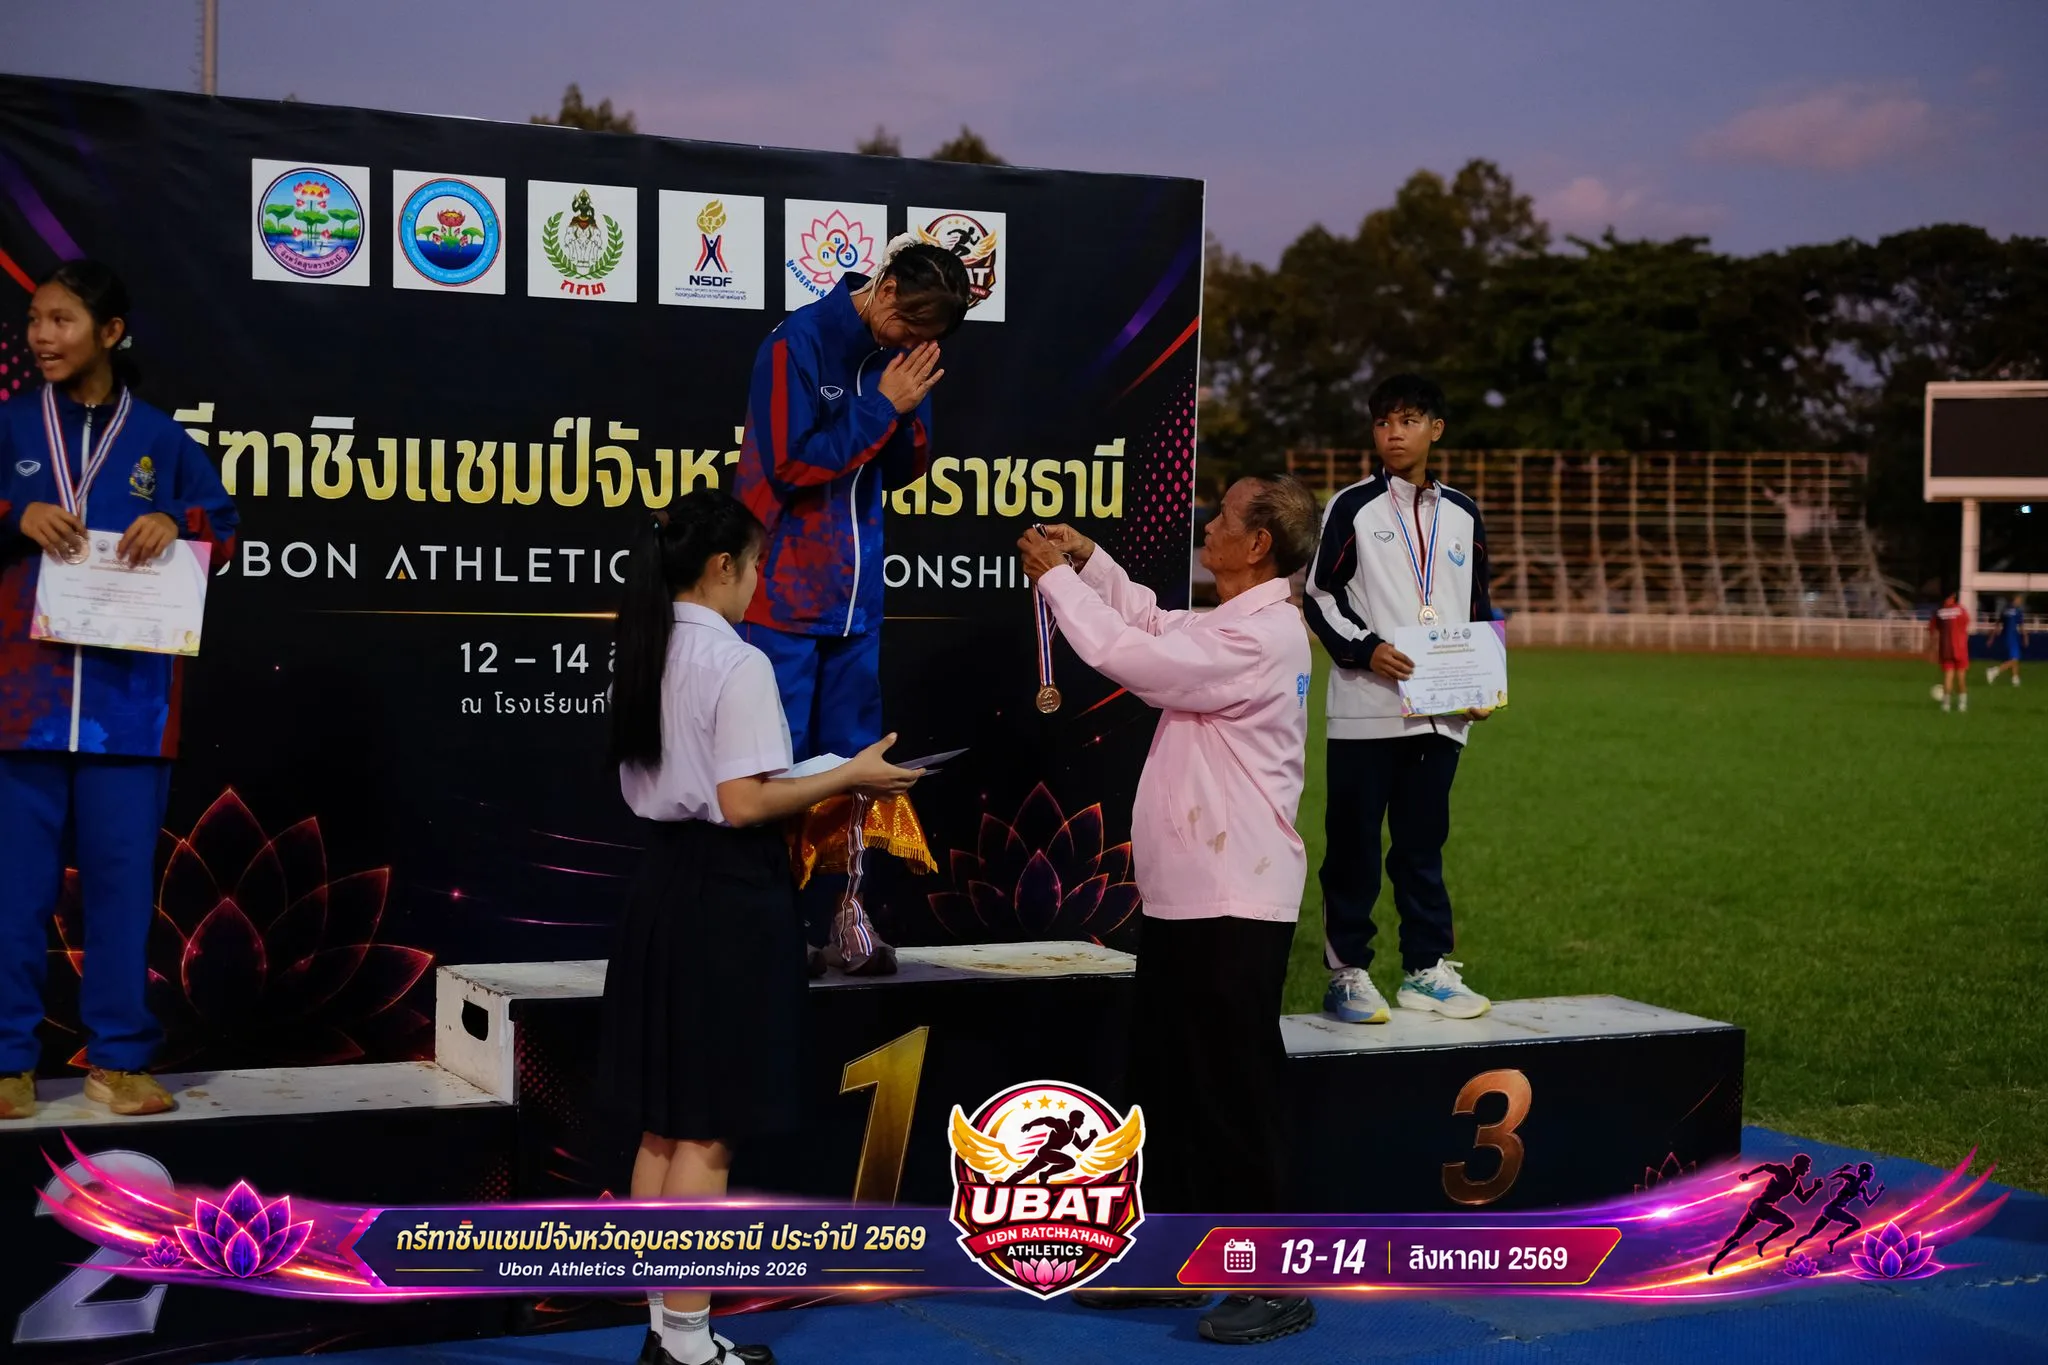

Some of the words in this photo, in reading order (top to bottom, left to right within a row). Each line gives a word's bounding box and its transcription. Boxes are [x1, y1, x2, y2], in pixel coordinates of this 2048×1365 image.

[560, 280, 606, 296] กกท
[689, 275, 733, 287] NSDF
[214, 541, 356, 579] BON
[386, 544, 630, 584] ATHLETIC
[460, 642, 498, 674] 12
[552, 643, 589, 675] 14
[461, 697, 482, 714] ณ
[495, 690, 606, 714] โรงเรียนกี
[839, 1026, 930, 1207] 1
[1441, 1068, 1533, 1206] 3
[12, 1149, 175, 1345] 2
